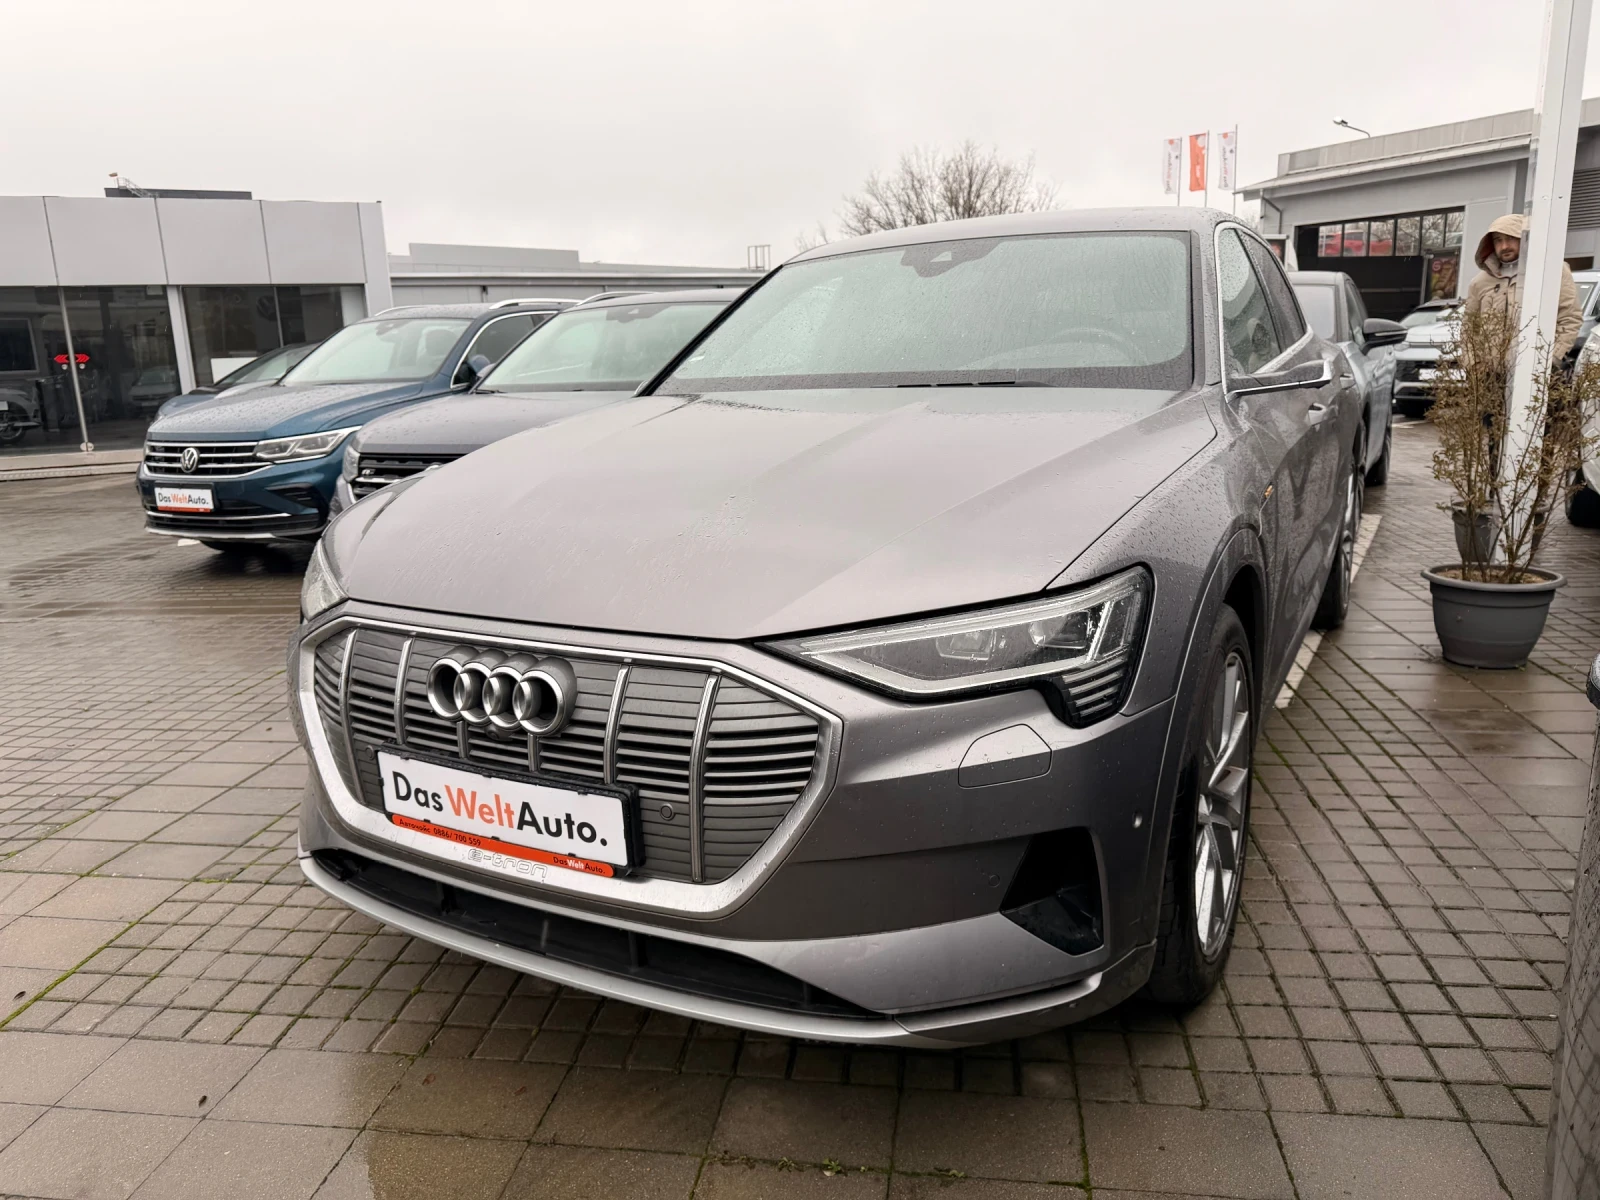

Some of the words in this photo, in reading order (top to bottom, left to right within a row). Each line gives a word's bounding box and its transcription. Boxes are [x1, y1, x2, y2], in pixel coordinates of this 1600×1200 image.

[454, 833, 467, 842] 700
[468, 837, 481, 846] 559
[468, 848, 548, 879] e-tron
